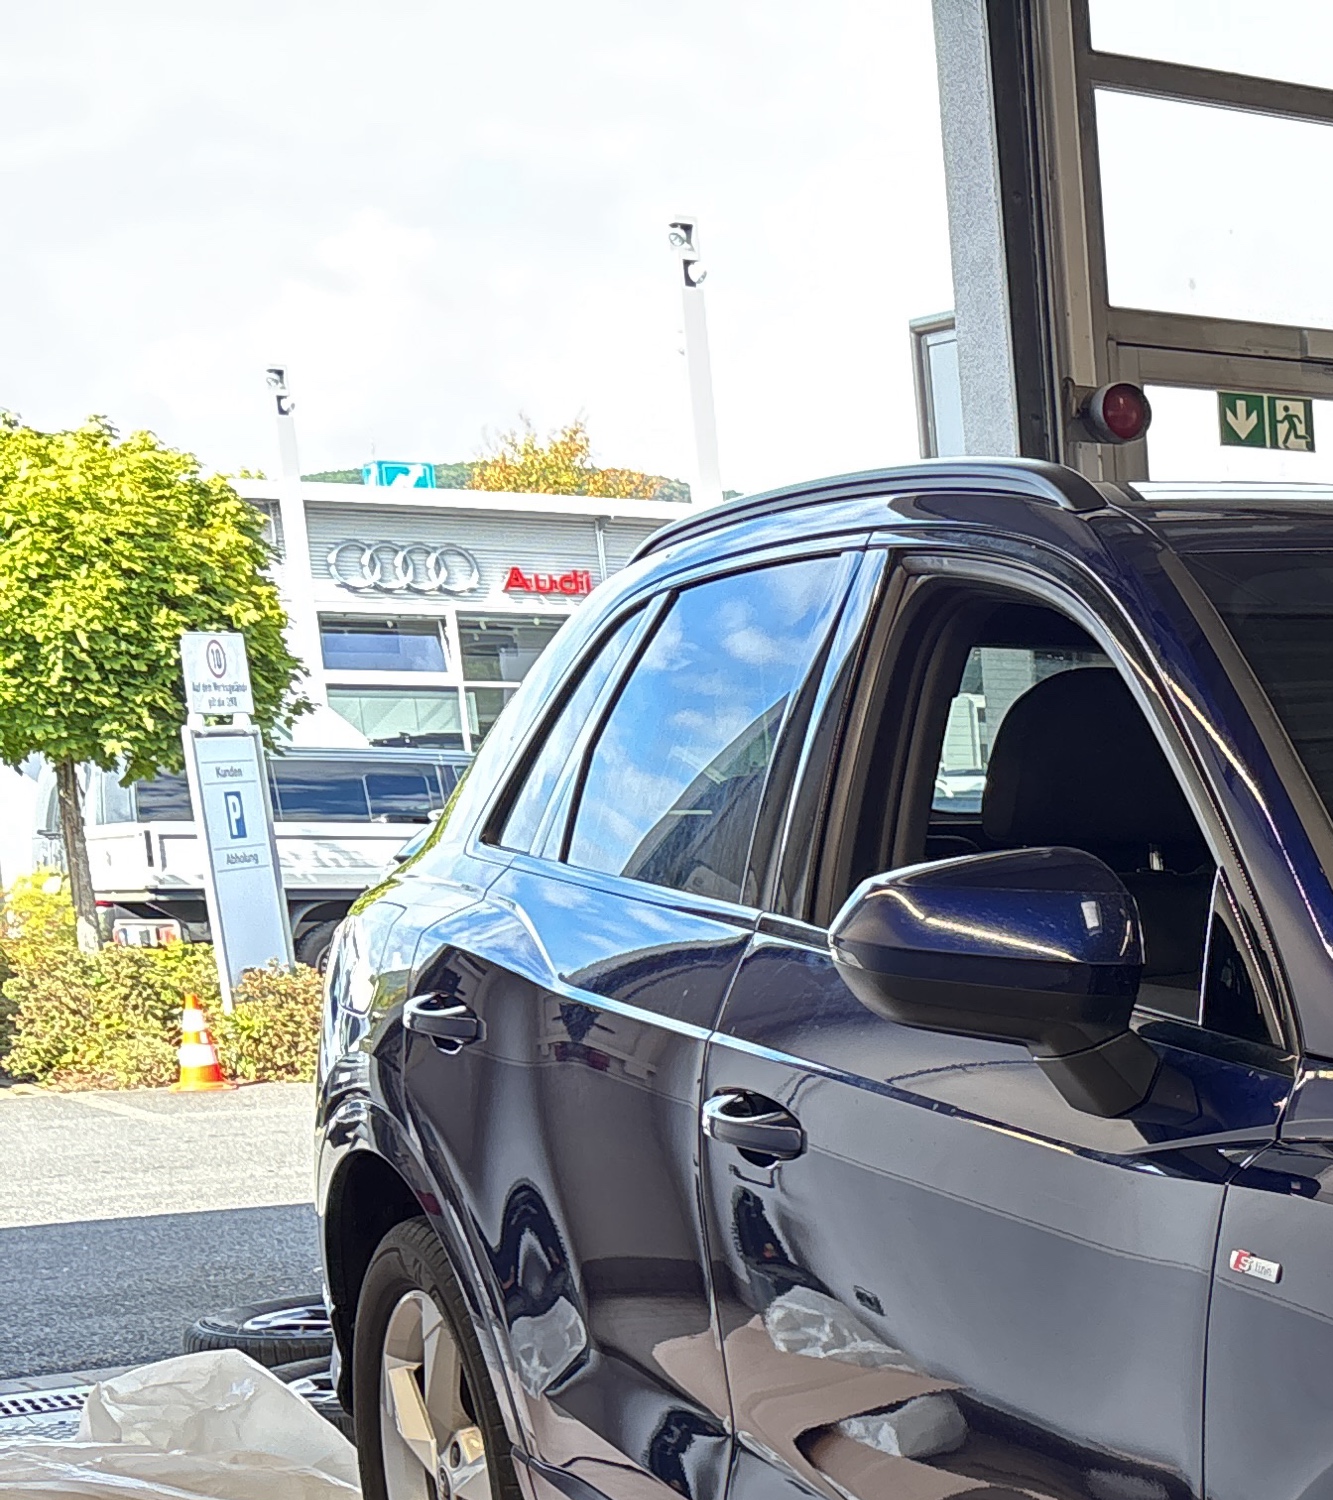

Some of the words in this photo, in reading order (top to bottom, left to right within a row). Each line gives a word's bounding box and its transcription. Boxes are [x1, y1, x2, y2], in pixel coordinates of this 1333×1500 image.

[502, 566, 592, 594] Audi
[211, 648, 222, 669] 10
[215, 766, 243, 778] Kunden
[227, 795, 241, 836] P
[226, 852, 259, 865] Abholung
